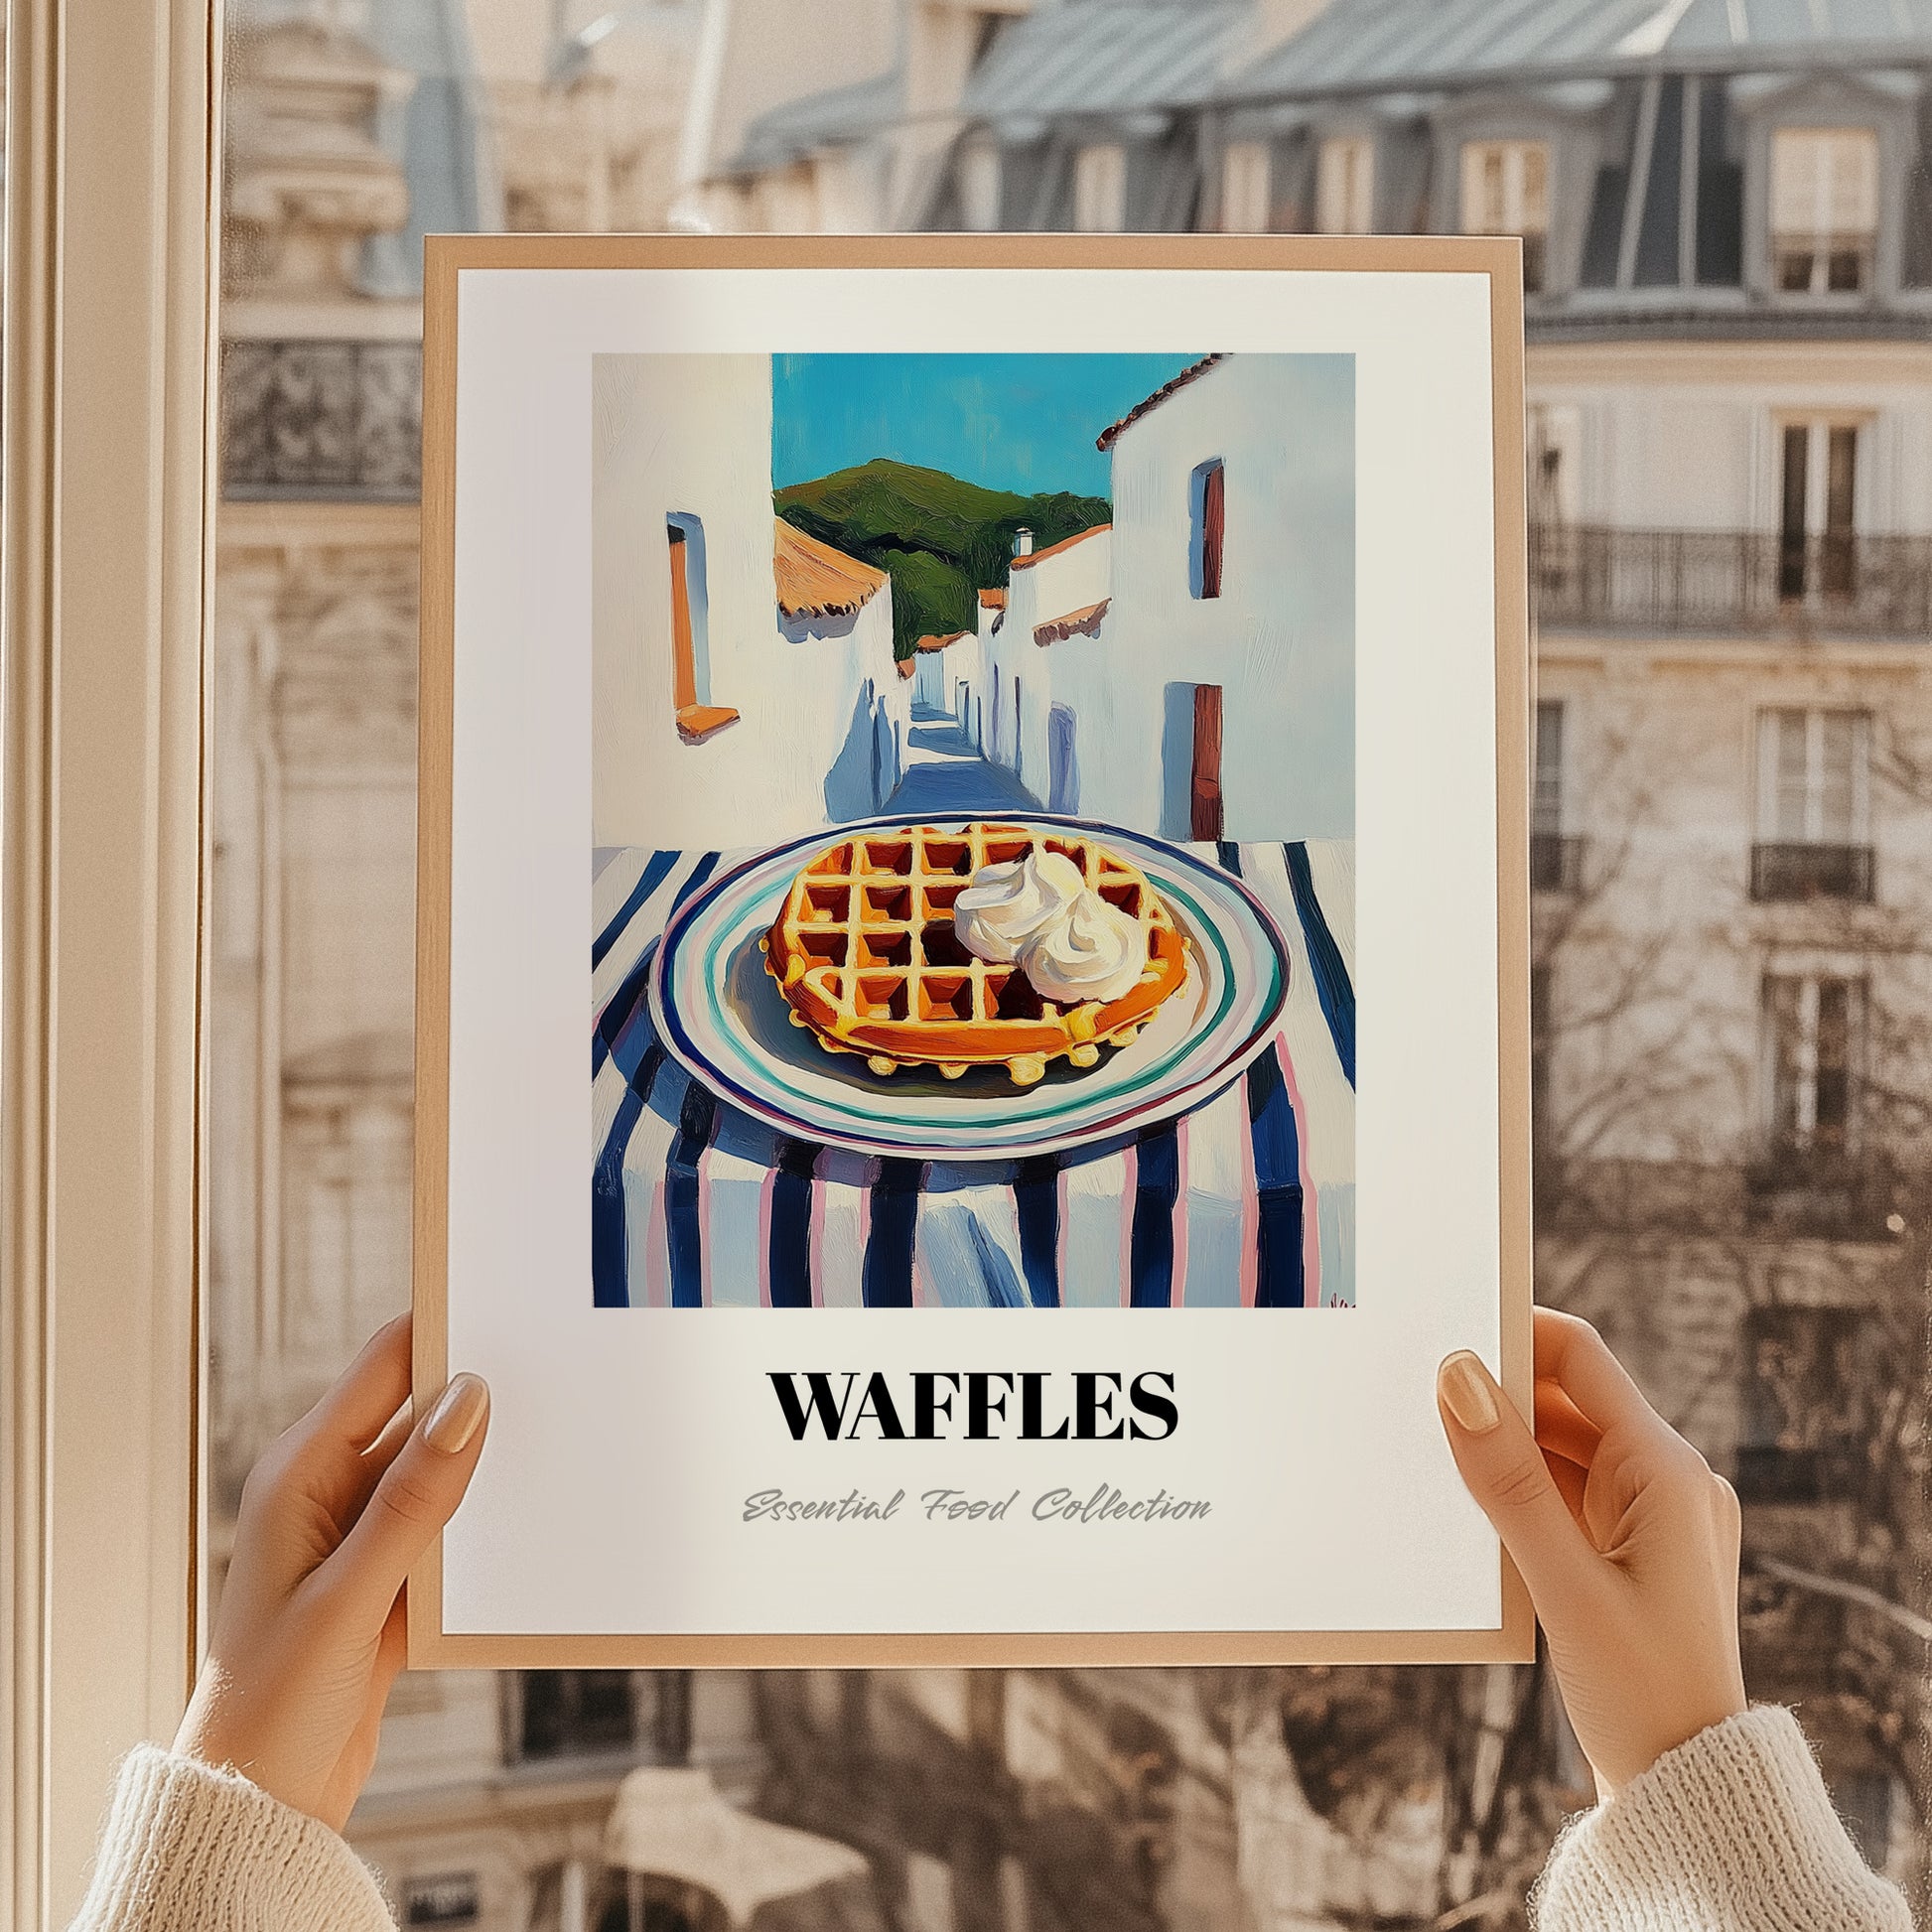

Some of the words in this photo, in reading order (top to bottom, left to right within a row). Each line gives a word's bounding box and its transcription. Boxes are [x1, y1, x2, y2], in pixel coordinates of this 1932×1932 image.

[765, 1371, 1178, 1441] WAFFLES
[743, 1488, 905, 1523] Essential
[920, 1488, 1021, 1522] Food
[1032, 1482, 1213, 1524] Collection
